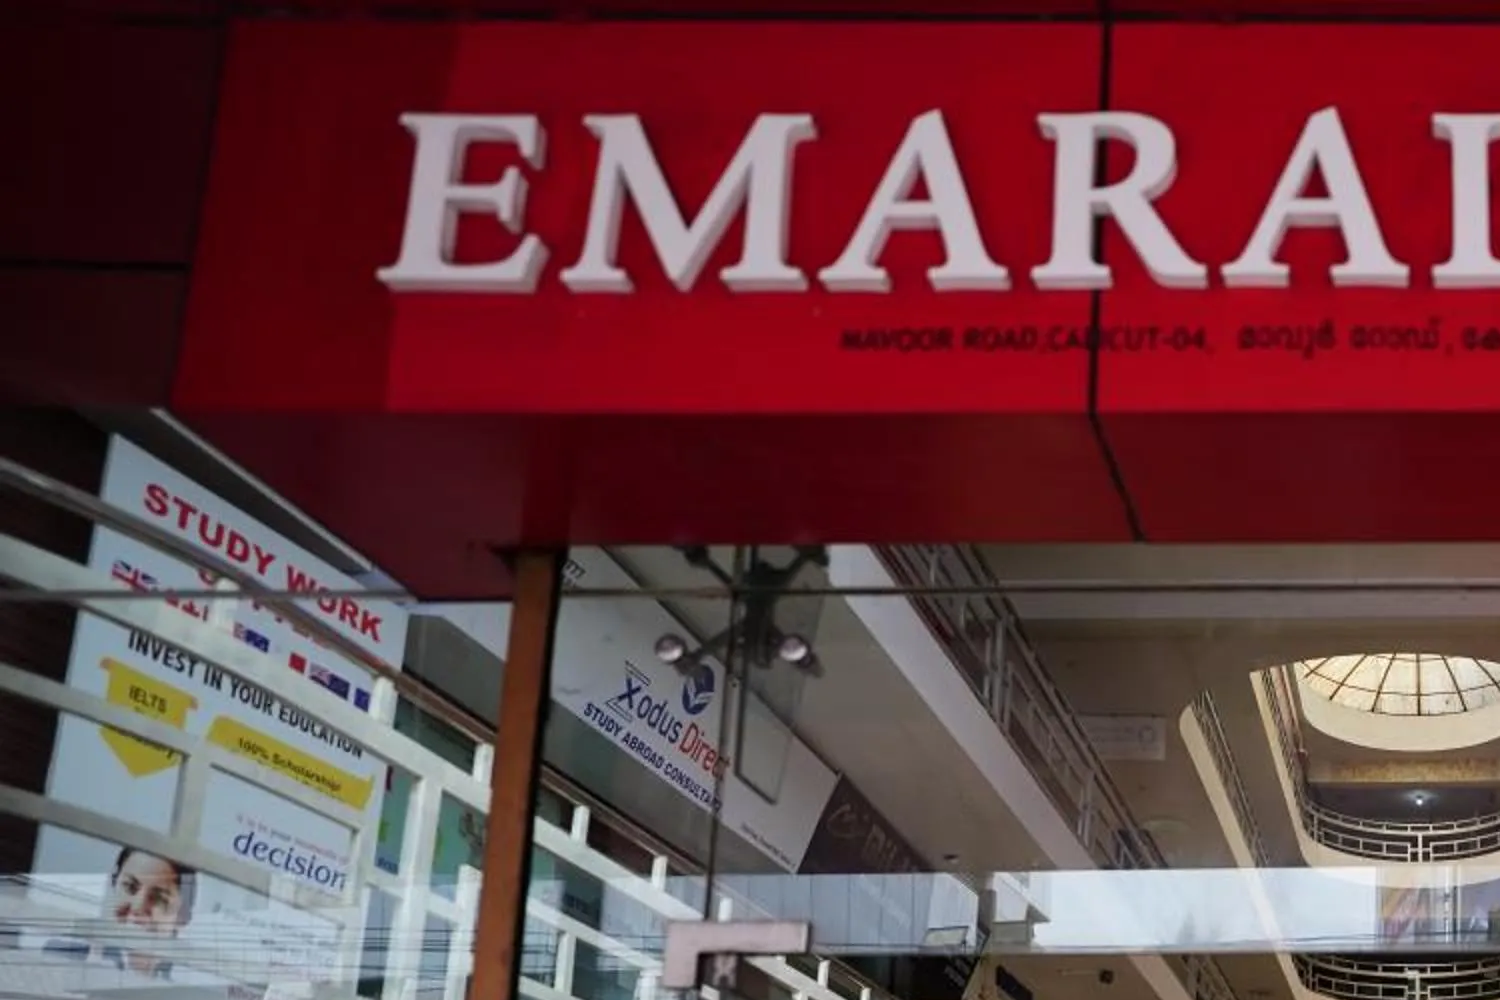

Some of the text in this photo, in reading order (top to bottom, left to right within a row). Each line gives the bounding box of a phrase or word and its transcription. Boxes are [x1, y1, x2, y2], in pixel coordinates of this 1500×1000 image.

[143, 483, 275, 577] STUDY
[286, 565, 383, 643] WORK
[128, 627, 199, 679] INVEST
[203, 663, 224, 690] IN
[229, 674, 273, 717] YOUR
[583, 703, 622, 737] STUDY
[232, 832, 348, 891] decision
